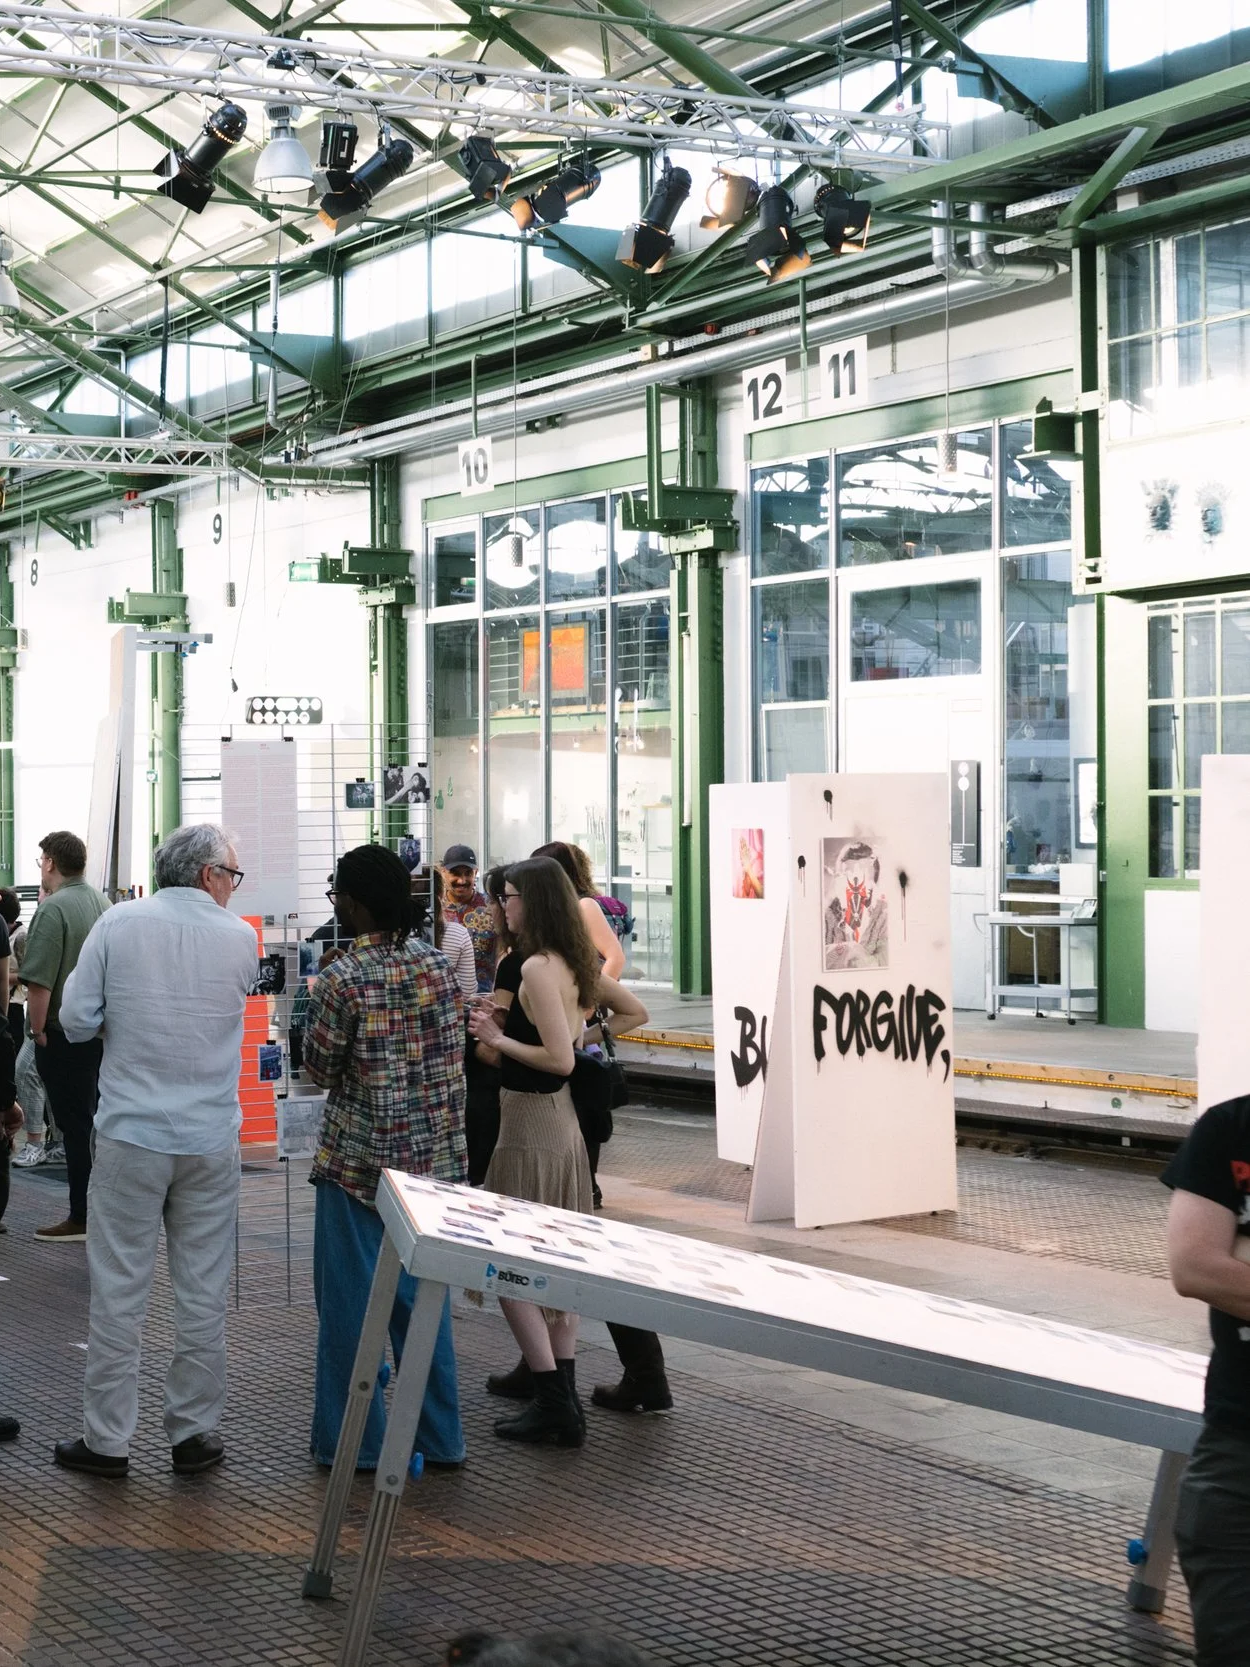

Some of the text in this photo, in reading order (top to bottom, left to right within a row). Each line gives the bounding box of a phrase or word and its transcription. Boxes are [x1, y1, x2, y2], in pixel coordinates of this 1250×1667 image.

[828, 349, 856, 399] 11
[747, 372, 783, 421] 12
[462, 447, 489, 487] 10
[212, 513, 222, 545] 9
[30, 558, 39, 587] 8
[813, 983, 950, 1084] FORGIVE,
